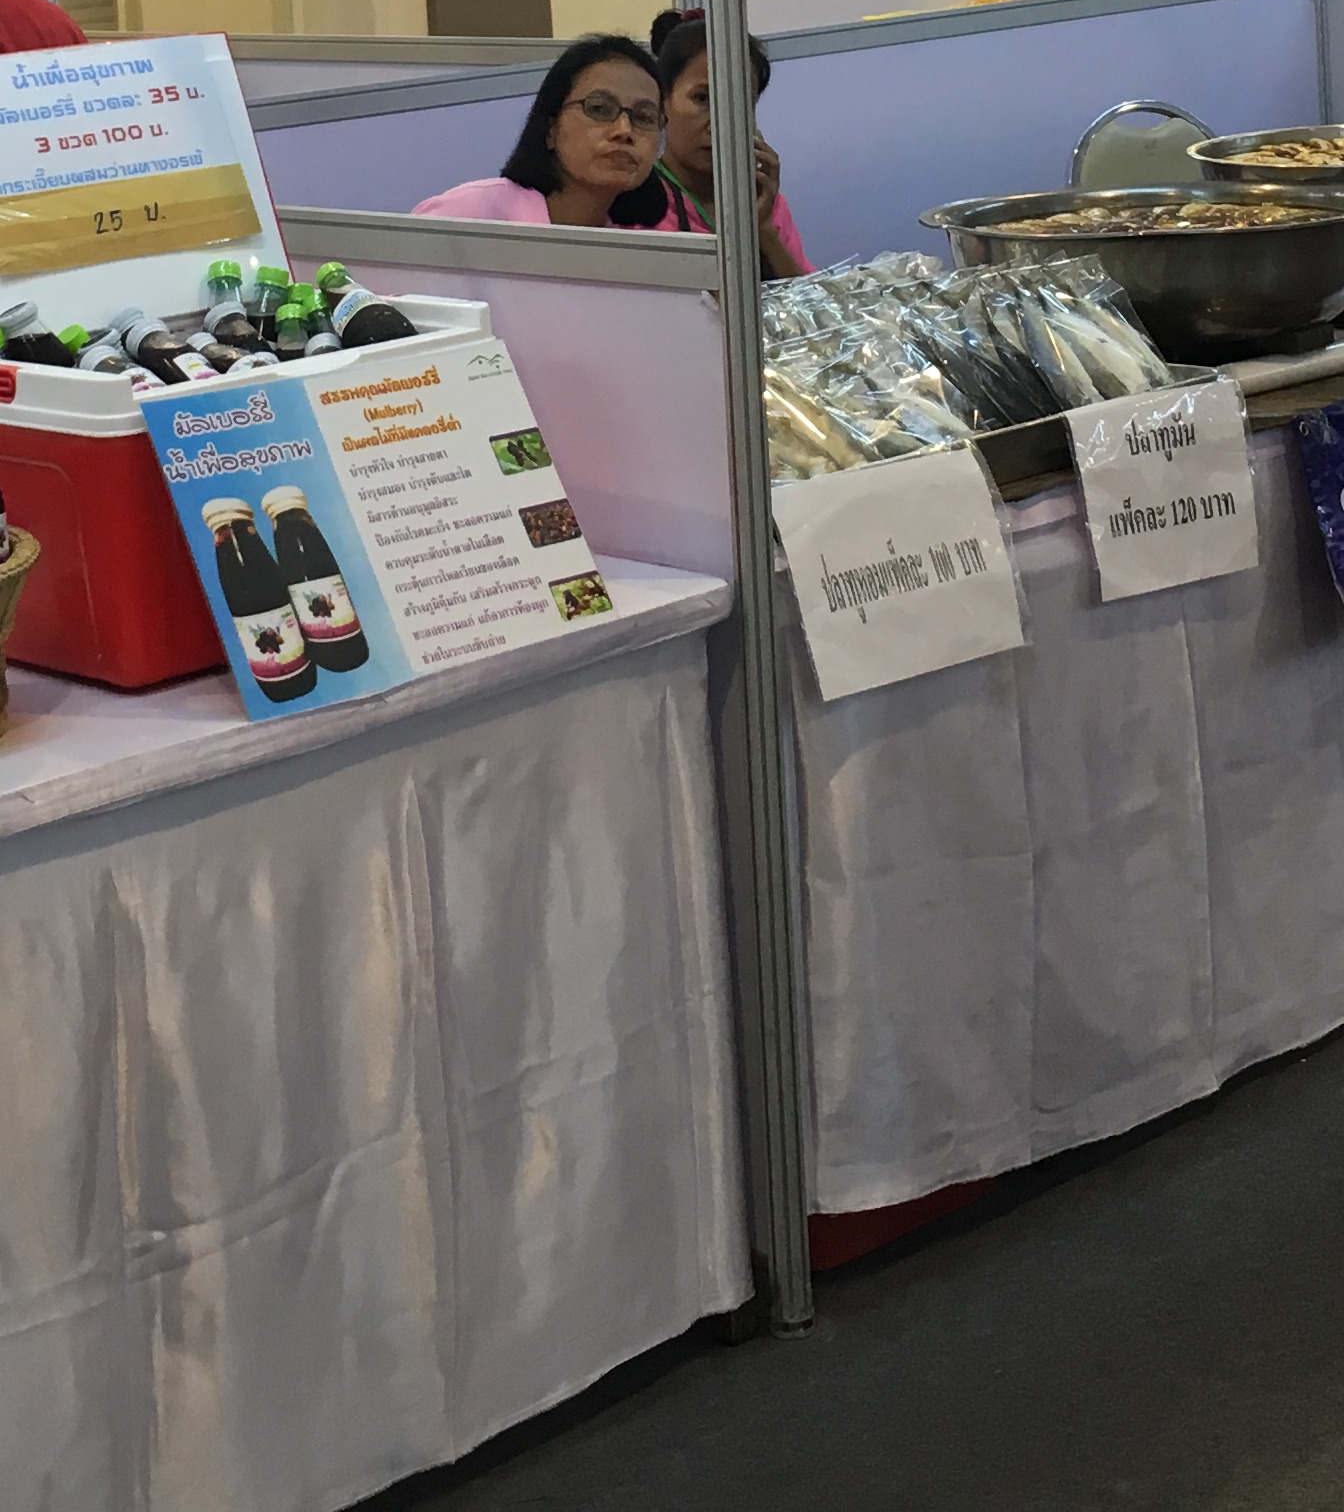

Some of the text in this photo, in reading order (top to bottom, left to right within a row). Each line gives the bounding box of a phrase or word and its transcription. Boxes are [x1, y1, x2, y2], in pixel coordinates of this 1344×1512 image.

[11, 57, 154, 89] น้ำเพื่อสุขภาพ
[83, 92, 142, 115] ขวดละ
[148, 85, 180, 105] 35
[186, 85, 205, 101] บ.
[34, 122, 169, 154] 3 ขวด 100 บ.
[93, 202, 166, 235] 25 บ.
[174, 392, 275, 437] มัลเบอร์รี่
[363, 398, 424, 424] (Mulberry)
[1124, 411, 1197, 462] ปลาทูมัน
[164, 440, 313, 483] น้ำเพื่อสุขภาพ
[349, 449, 449, 479] บำรุงหัวใจ บำรุงสายตา
[357, 482, 406, 503] บำรุงสมอง
[1109, 491, 1236, 538] แพ็คละ 120 บาท
[928, 541, 956, 584] 100
[954, 537, 987, 577] บาท
